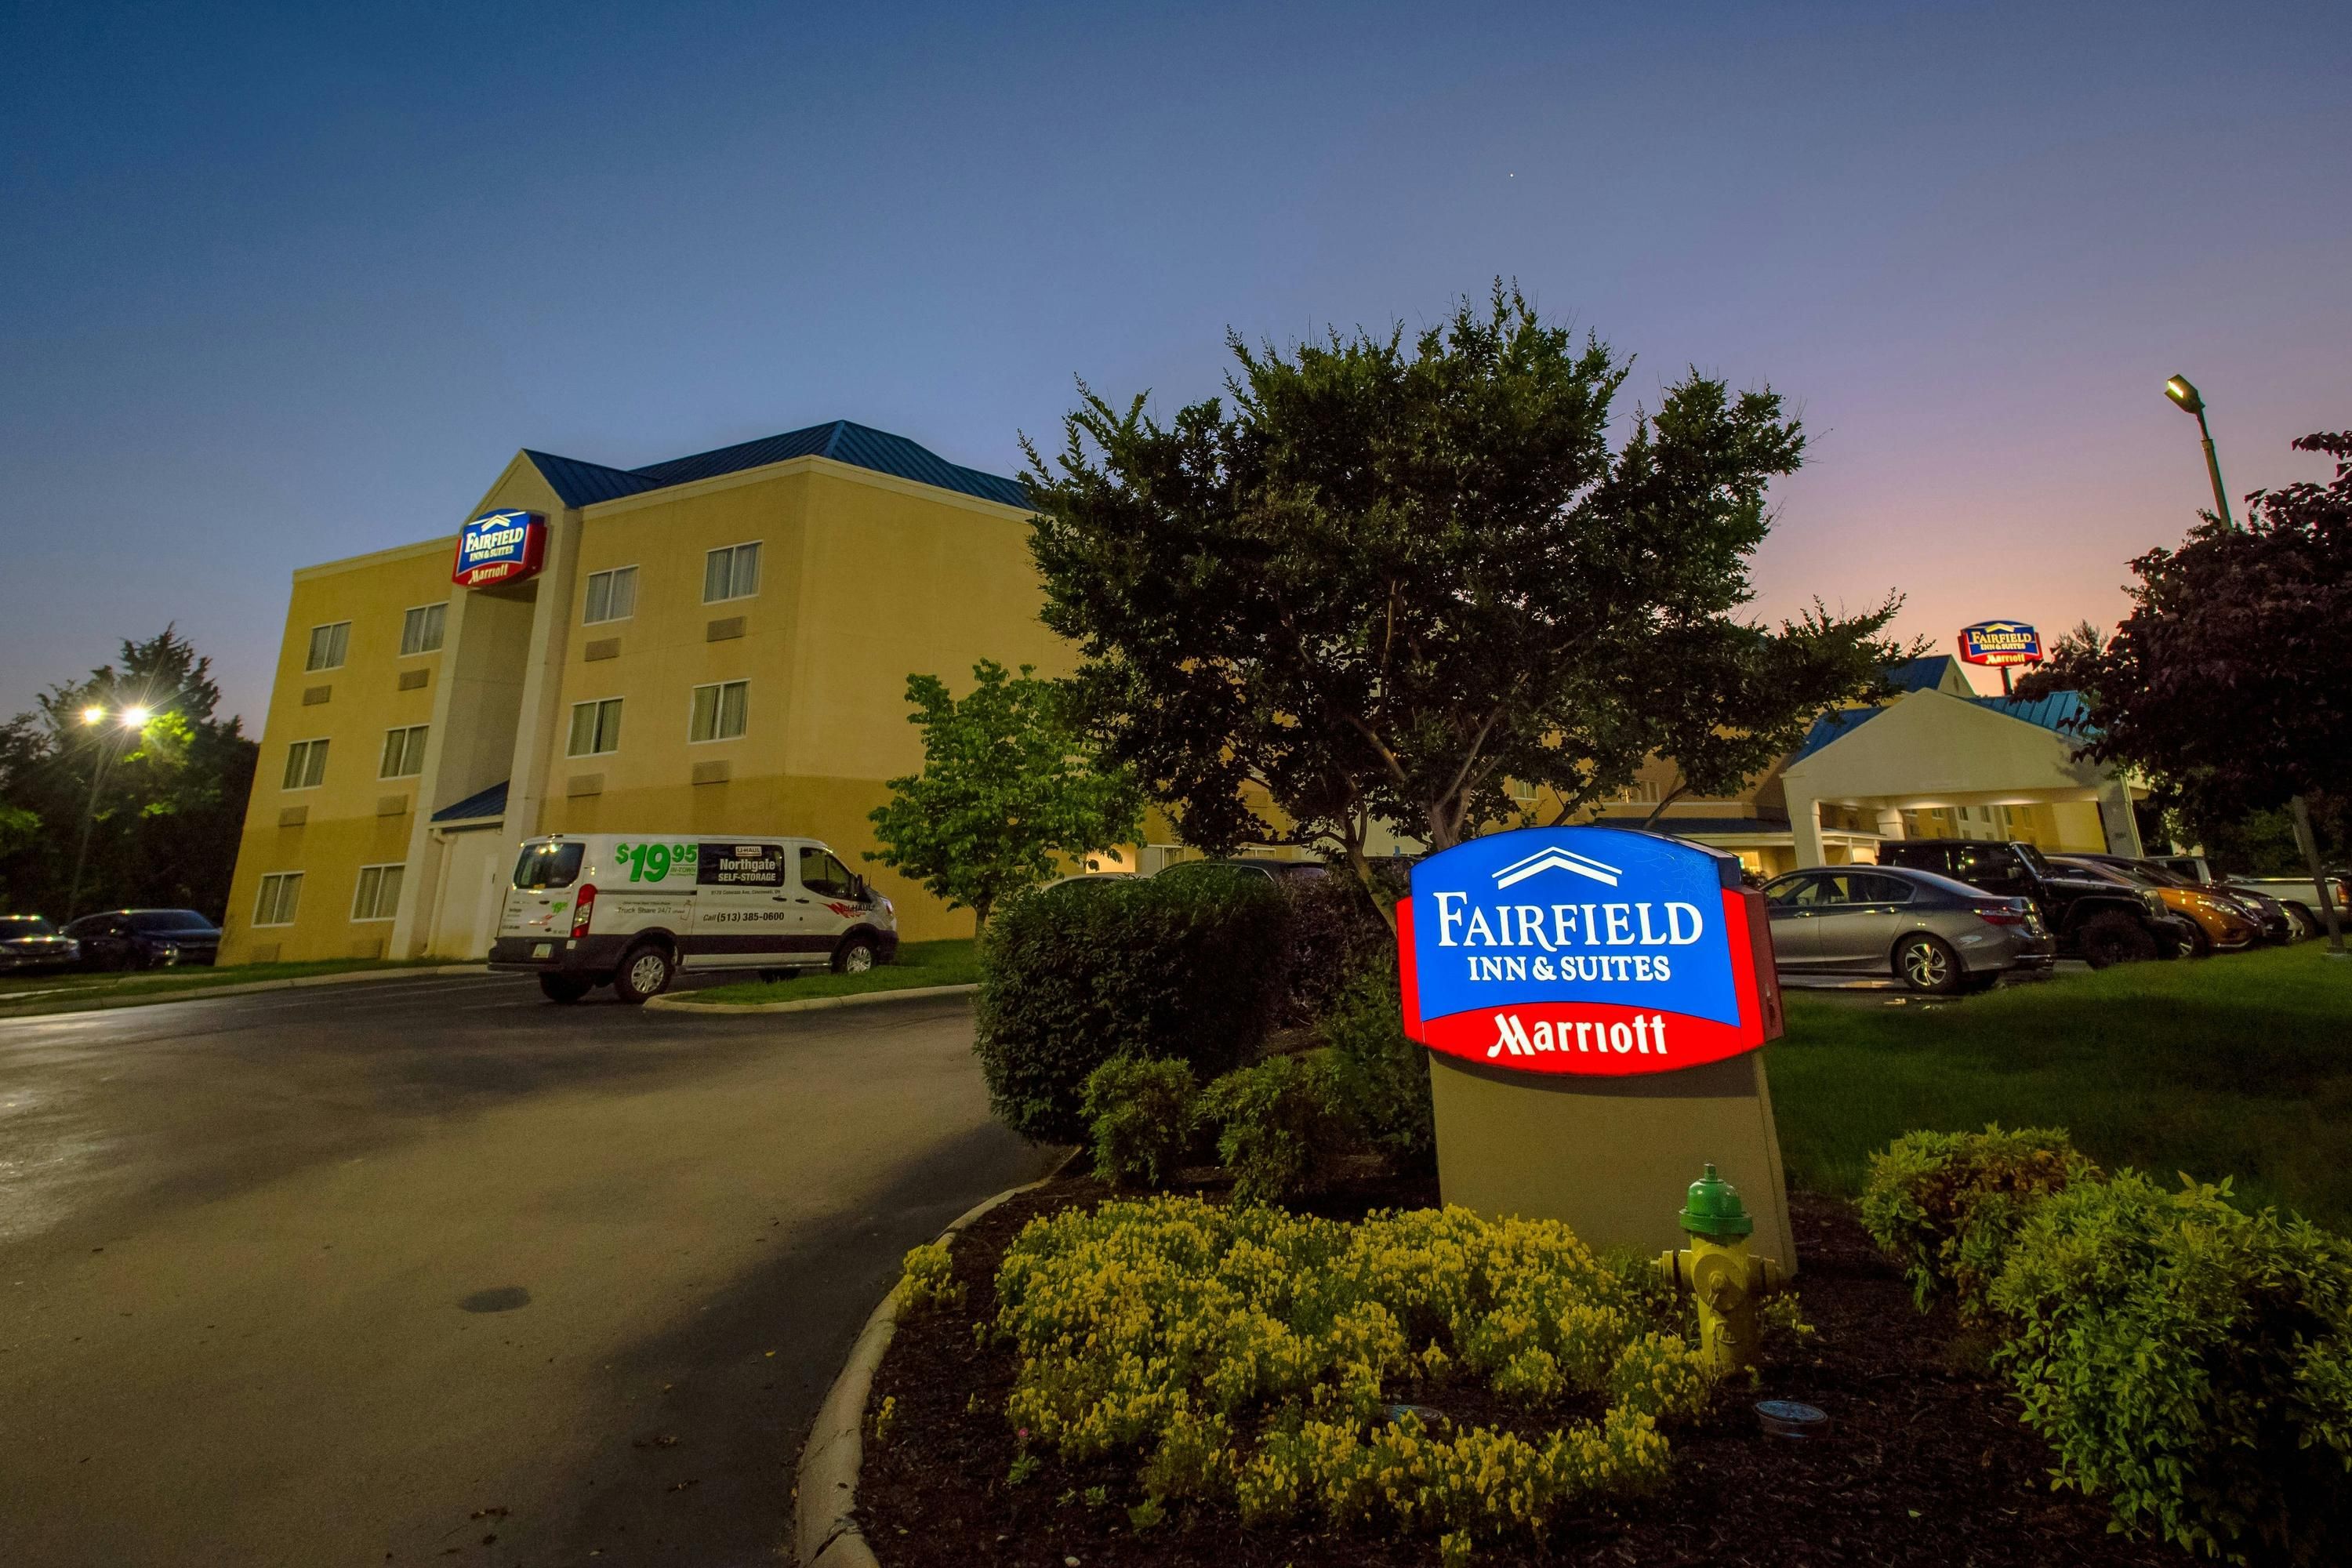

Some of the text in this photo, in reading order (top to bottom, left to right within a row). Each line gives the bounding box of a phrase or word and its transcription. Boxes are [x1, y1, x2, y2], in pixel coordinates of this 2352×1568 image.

[465, 527, 524, 554] FAIRFIELD
[470, 545, 514, 562] INN & SUITES
[468, 563, 509, 585] Marriott
[1971, 631, 2032, 644] FAIRFIELD
[1985, 653, 2026, 665] Marriott
[720, 858, 776, 873] Northgate
[718, 873, 776, 882] SELF-STORAGE
[717, 912, 741, 923] (513)
[742, 912, 785, 921] 385-0600
[1432, 891, 1704, 953] FAIRFIELD
[1467, 955, 1671, 982] INN & SUITES
[1486, 1013, 1668, 1058] Marriott
